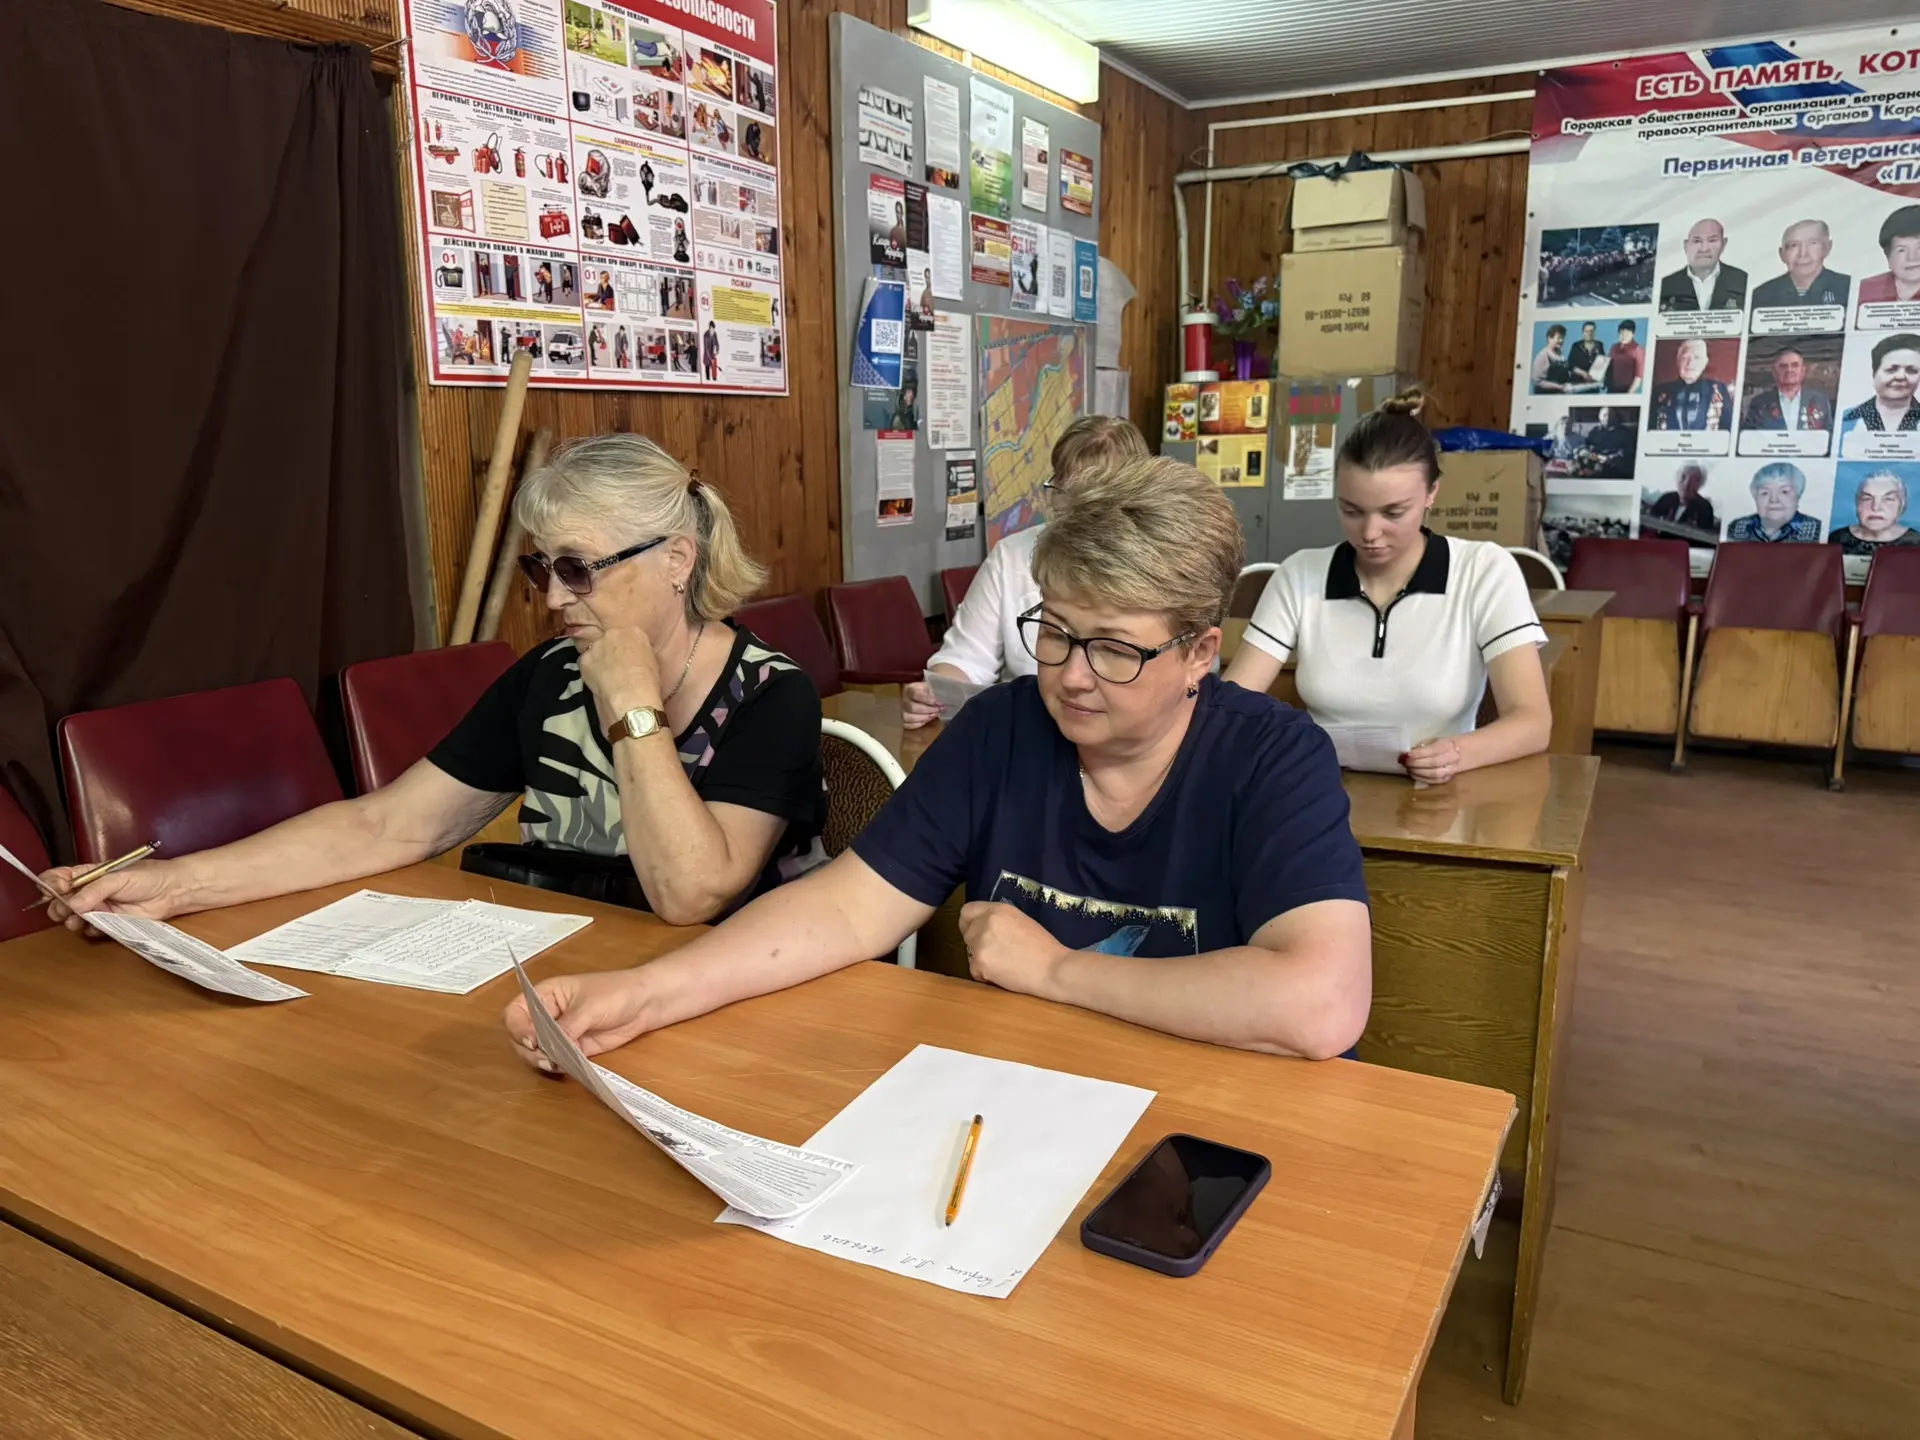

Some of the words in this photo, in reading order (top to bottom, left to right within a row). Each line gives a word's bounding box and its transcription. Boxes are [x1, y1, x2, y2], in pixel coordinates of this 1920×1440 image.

[655, 0, 756, 42] ОПАСНОСТИ
[1638, 75, 1701, 98] ЕСТЬ
[1713, 60, 1842, 90] ПАМЯТЬ,
[1564, 116, 1633, 133] Городская
[1638, 107, 1736, 125] общественная
[1750, 97, 1847, 116] организация
[1638, 115, 1793, 139] правоохранительных
[1806, 110, 1869, 124] органов
[1663, 152, 1790, 178] Первичная
[442, 252, 456, 264] 01
[584, 270, 596, 280] 01
